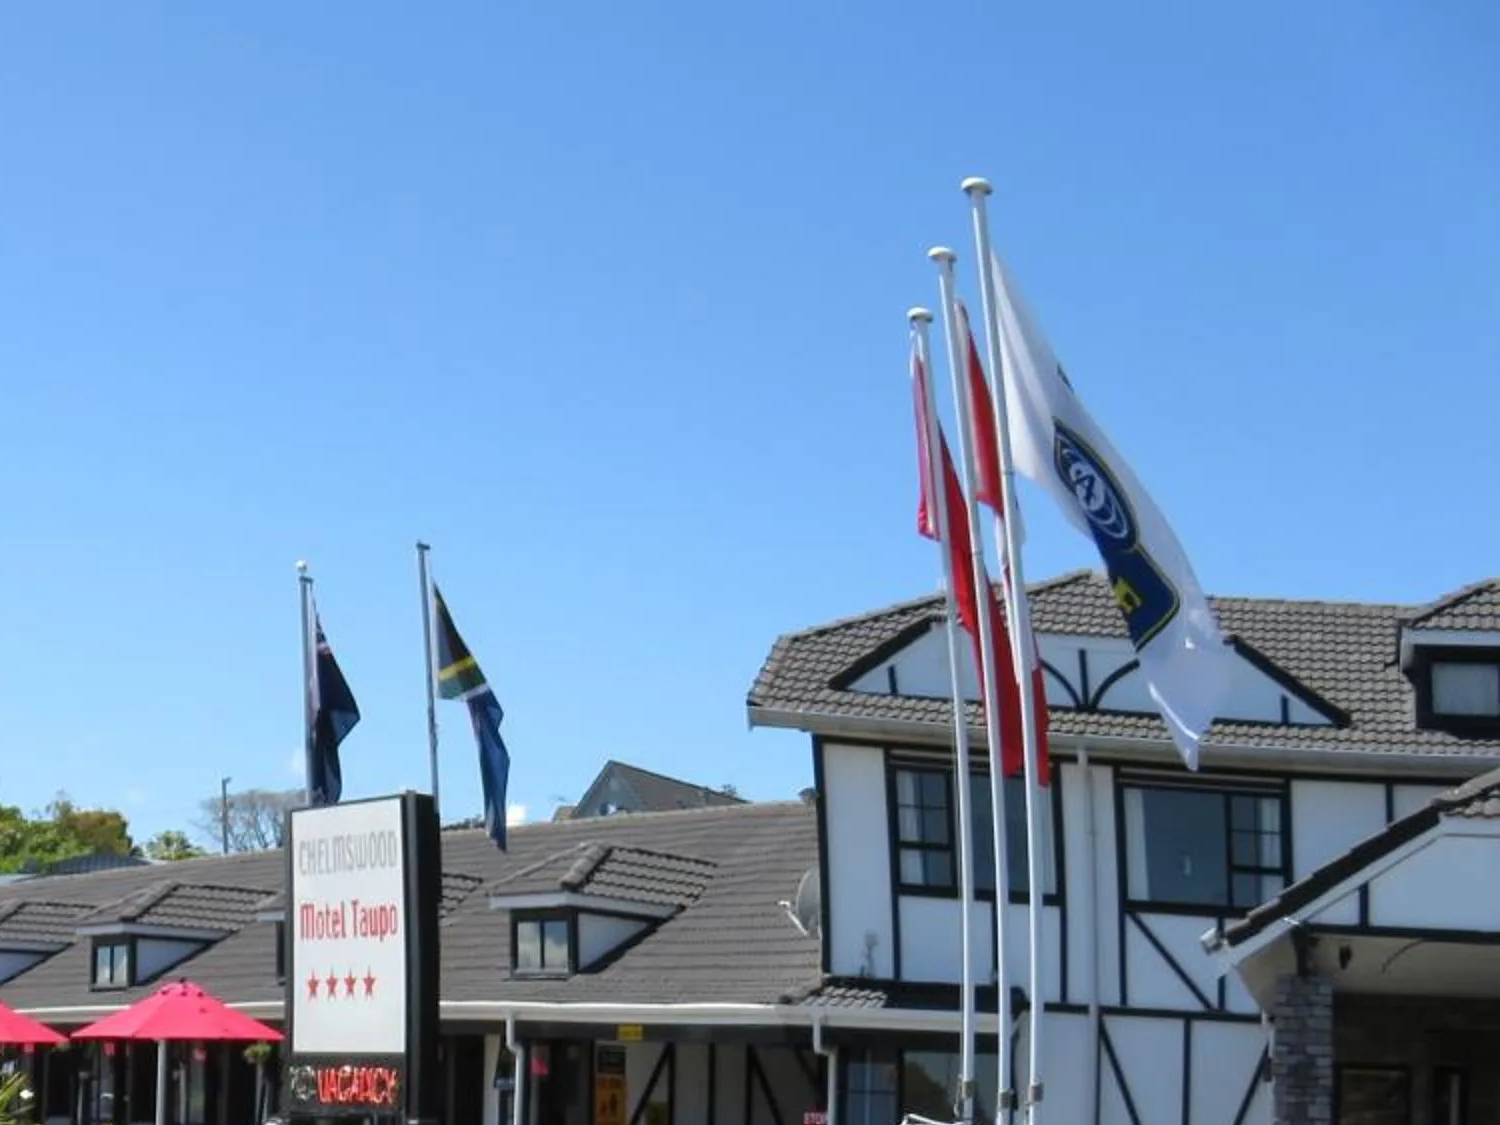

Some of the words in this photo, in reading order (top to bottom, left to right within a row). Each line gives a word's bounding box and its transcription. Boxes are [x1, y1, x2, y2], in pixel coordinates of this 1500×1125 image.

[299, 830, 398, 876] CHELMSWOOD
[299, 900, 347, 940] Motel
[351, 898, 398, 942] Taupo
